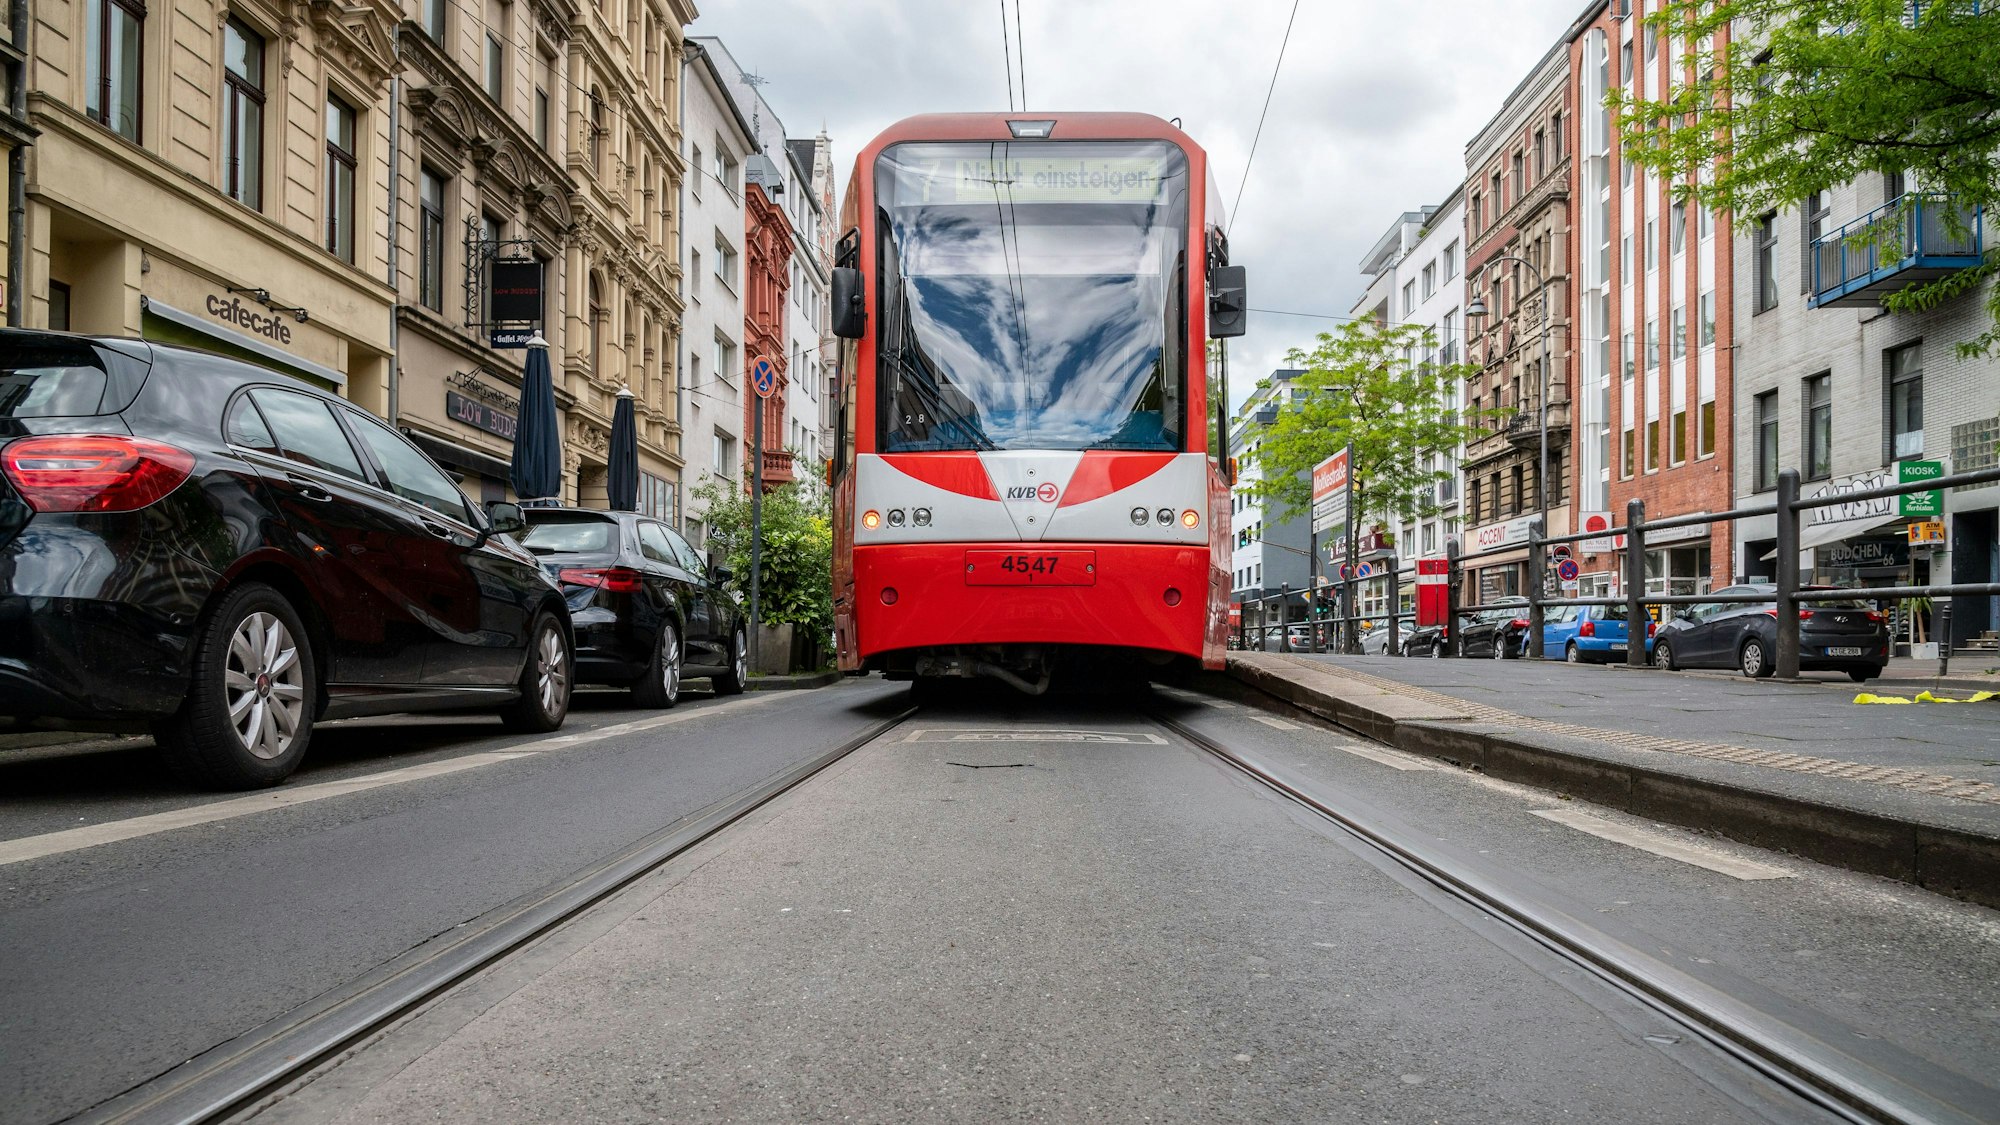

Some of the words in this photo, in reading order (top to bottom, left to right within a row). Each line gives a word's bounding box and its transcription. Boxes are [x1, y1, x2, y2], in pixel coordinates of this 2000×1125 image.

[1033, 161, 1150, 195] einsteigen
[206, 294, 291, 345] cafecafe
[457, 396, 483, 424] LOW
[489, 410, 518, 438] BUDG
[1313, 461, 1347, 494] Moltkestraße
[1905, 466, 1936, 475] KIOSK
[1006, 486, 1037, 499] KVB
[1478, 526, 1506, 547] ACCENT
[1001, 555, 1059, 574] 4547
[1882, 553, 1895, 566] 66
[1027, 573, 1033, 582] 1
